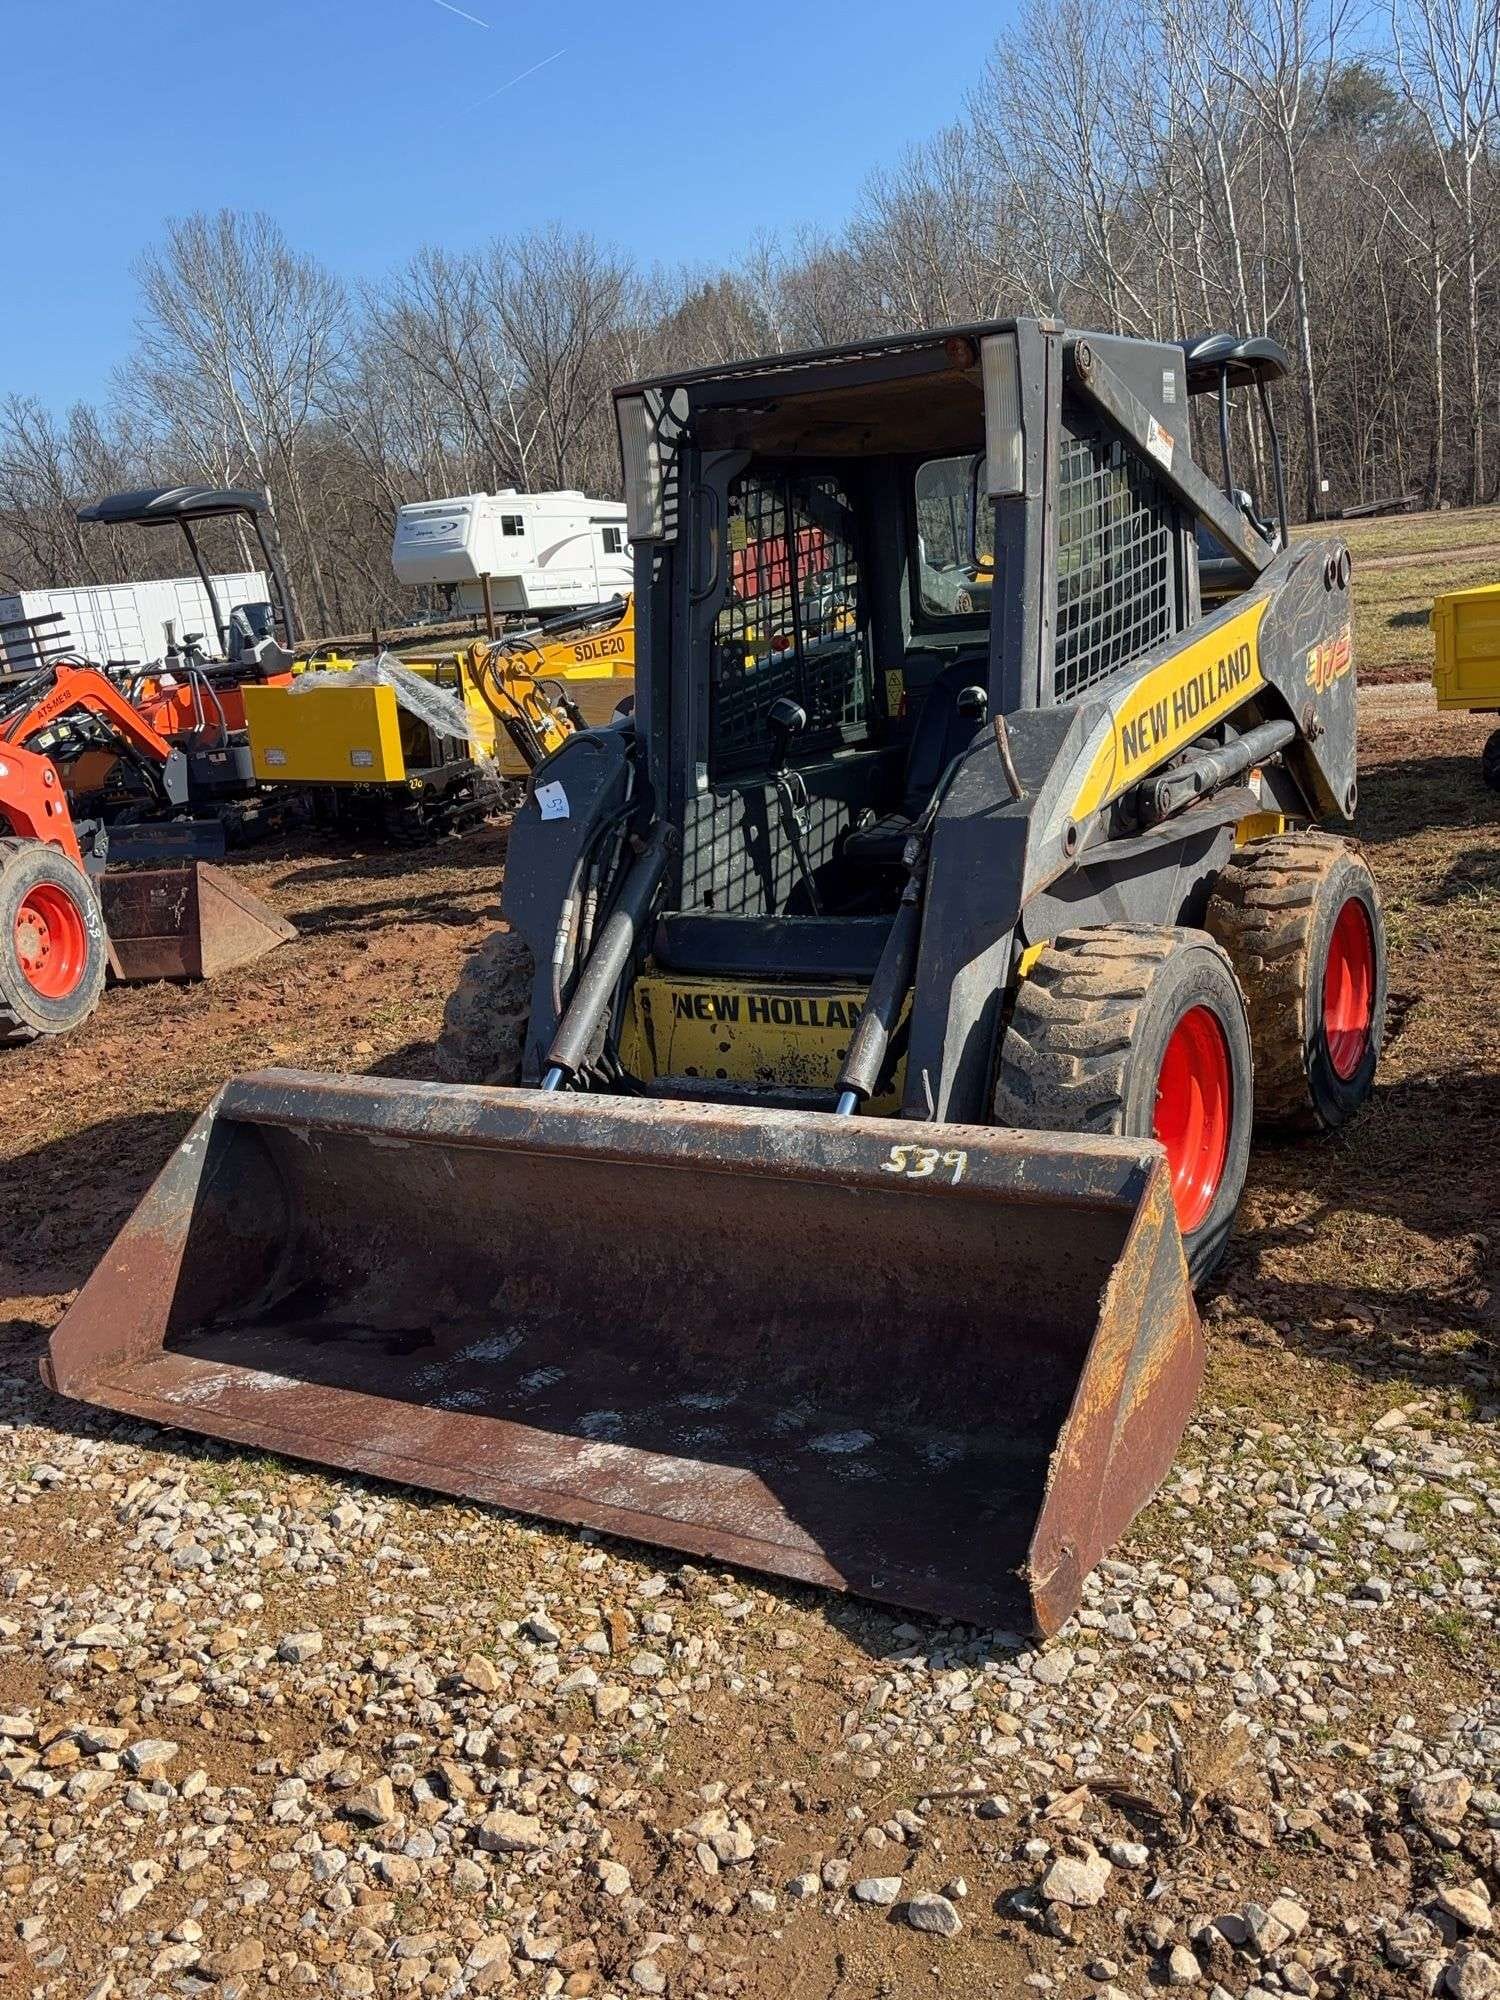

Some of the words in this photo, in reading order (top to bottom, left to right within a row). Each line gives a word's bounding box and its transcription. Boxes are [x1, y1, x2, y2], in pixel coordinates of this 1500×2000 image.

[574, 636, 625, 662] SDLE20
[1121, 697, 1168, 767] NEW
[1172, 642, 1250, 730] HOLLAND
[672, 992, 740, 1022] NEW
[747, 996, 865, 1029] HOLLAN
[879, 1144, 968, 1186] 539
